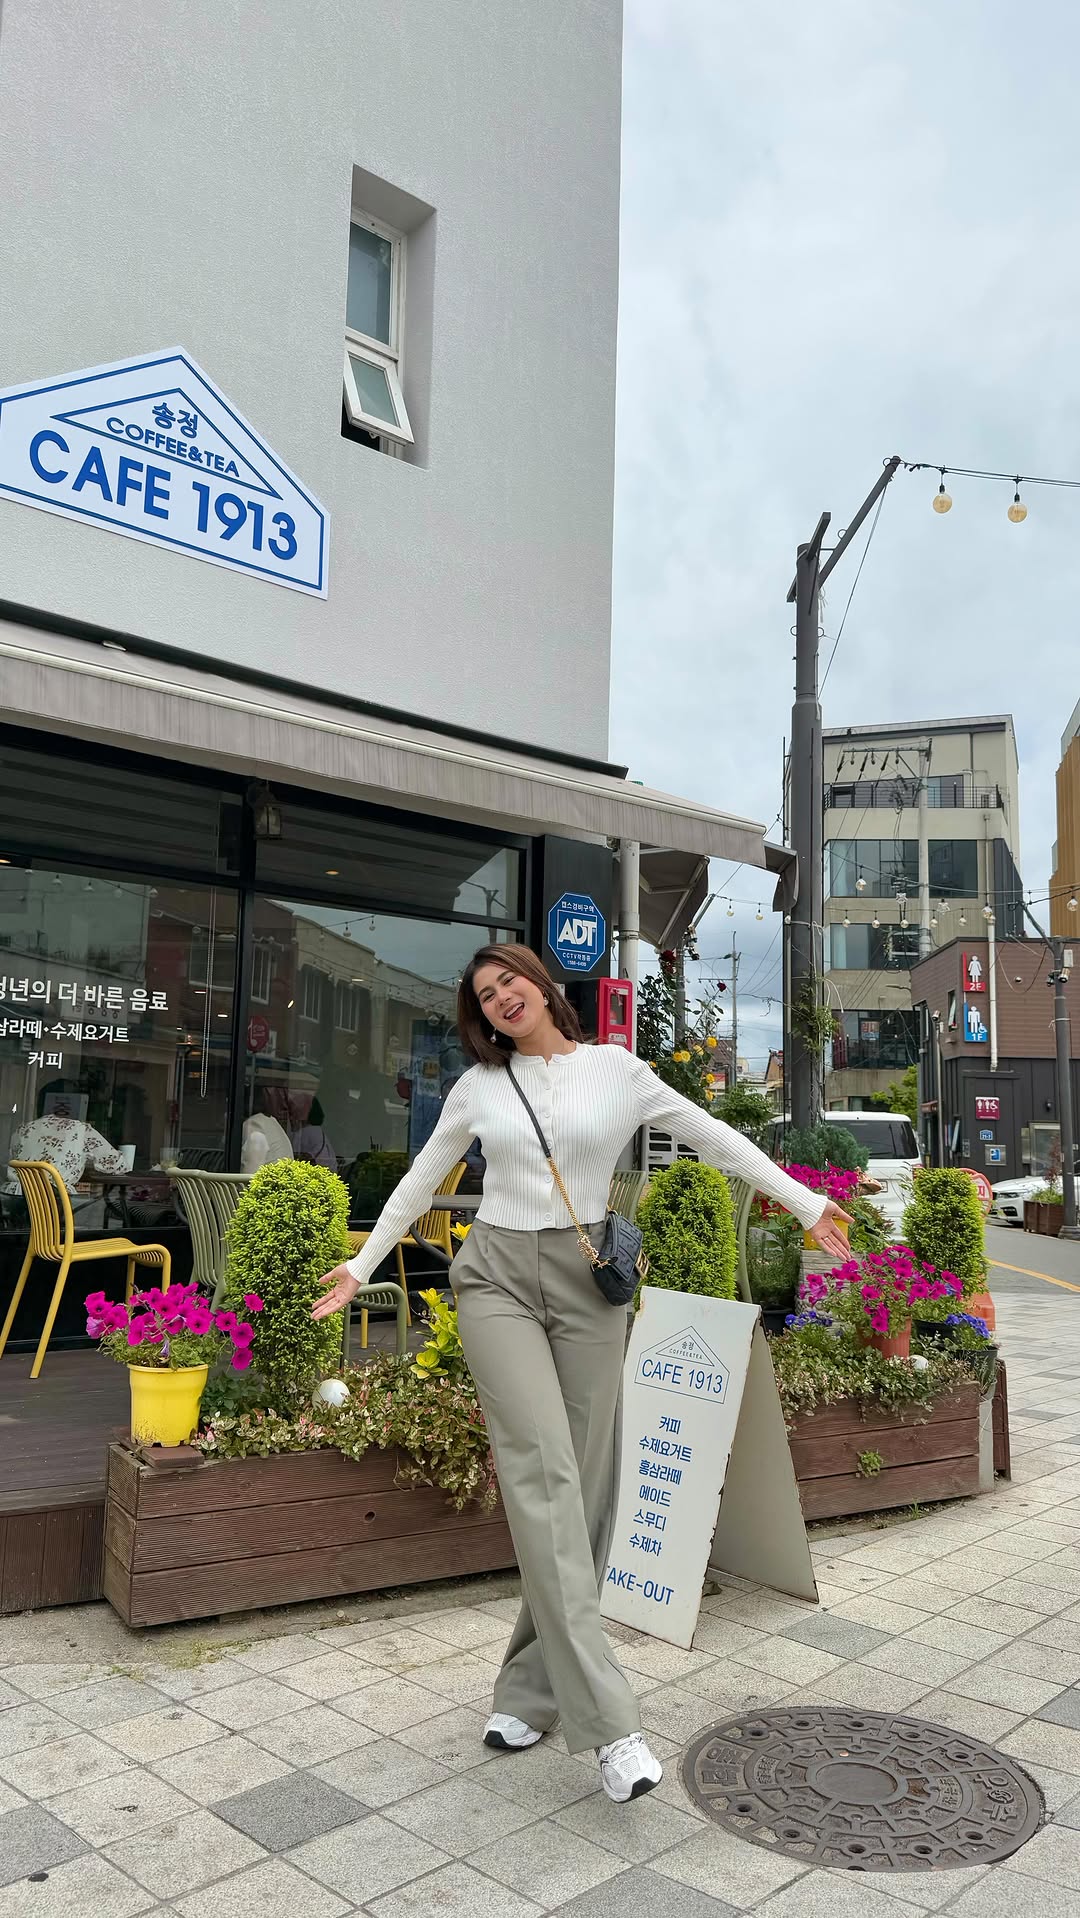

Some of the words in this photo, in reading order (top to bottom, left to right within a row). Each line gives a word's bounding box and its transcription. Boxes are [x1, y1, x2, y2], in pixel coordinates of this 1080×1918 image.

[152, 402, 198, 439] 송정
[106, 417, 240, 478] COFFEE&TEA
[29, 429, 171, 520] CAFE
[192, 481, 298, 561] 1913
[557, 918, 597, 947] ADT
[58, 983, 77, 1006] 더
[84, 985, 125, 1009] 바른
[129, 988, 169, 1012] 음료
[970, 983, 982, 991] 2F
[971, 1033, 983, 1041] 1F
[27, 1051, 63, 1069] 커피
[682, 1341, 695, 1351] 송정
[642, 1359, 684, 1385] CAFE
[688, 1369, 723, 1394] 1913
[659, 1416, 681, 1435] 커피
[639, 1436, 693, 1462] 수제요거트
[639, 1459, 682, 1485] 홍삼라떼
[639, 1485, 671, 1507] 에이드
[633, 1509, 667, 1531] 스무디
[629, 1533, 662, 1556] 수제차
[607, 1566, 674, 1605] AKE-OUT
